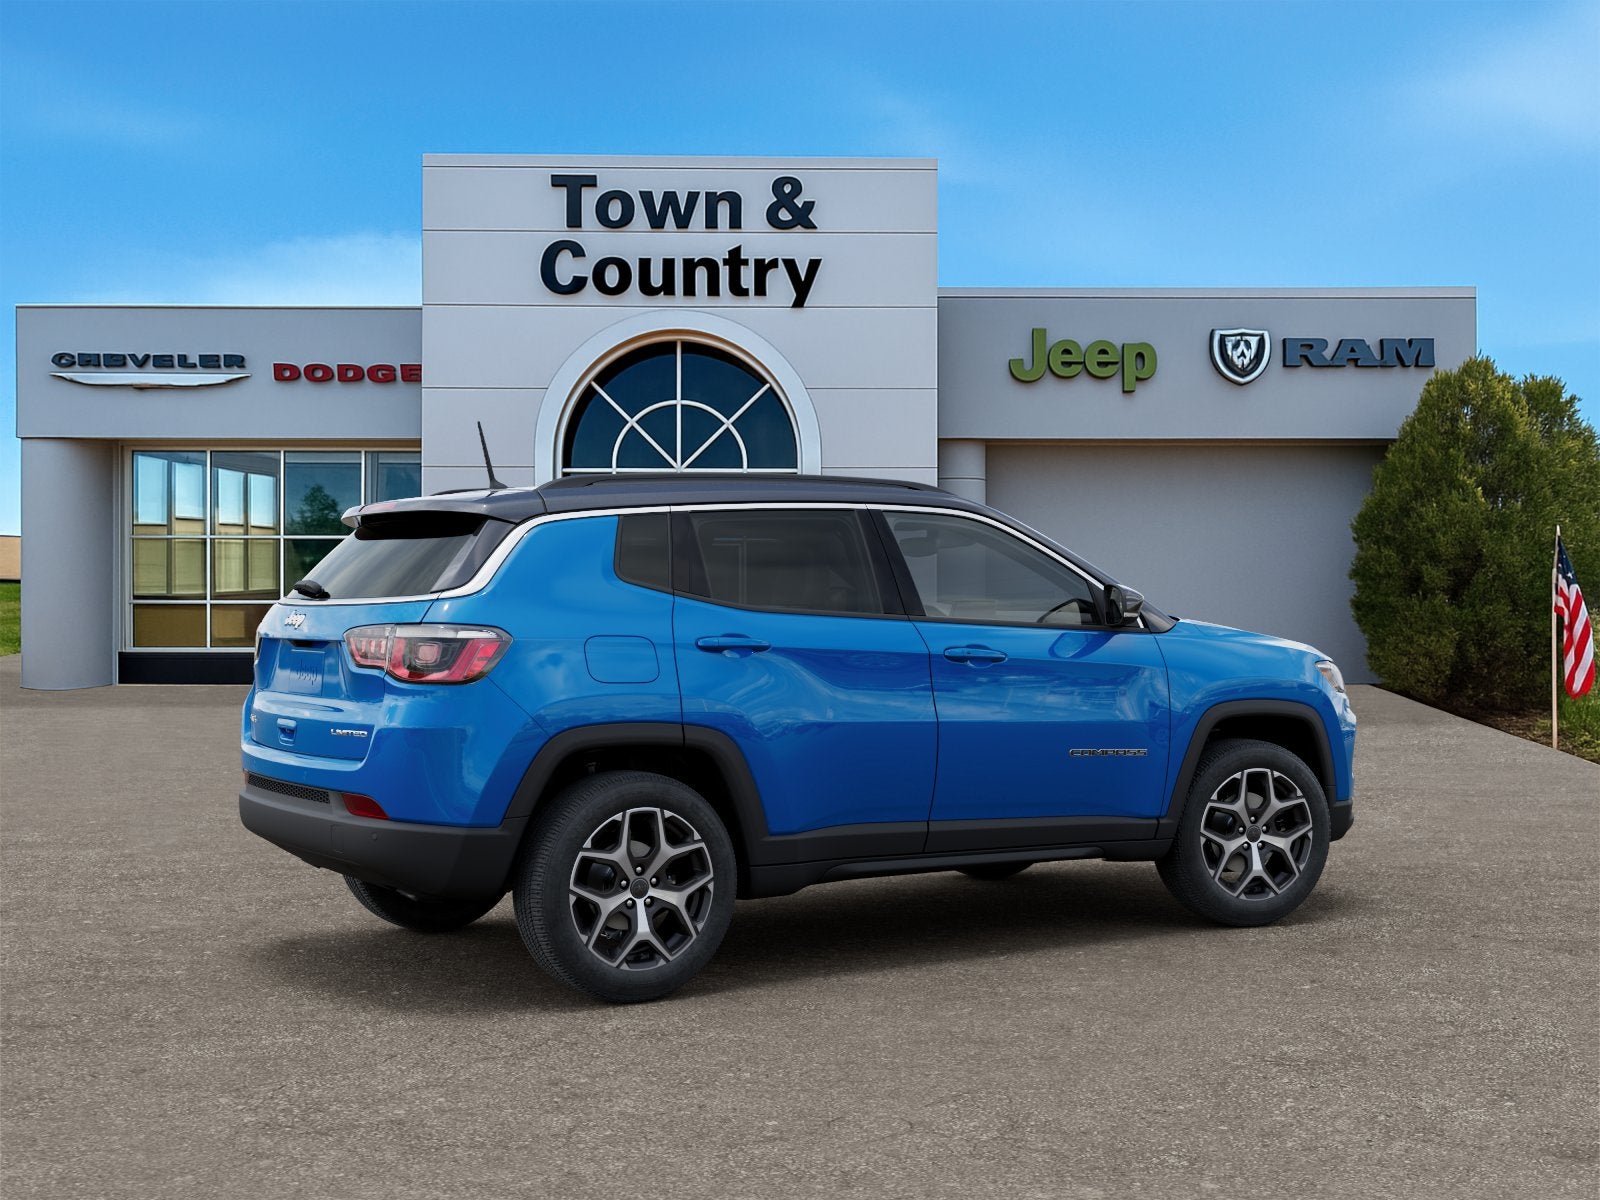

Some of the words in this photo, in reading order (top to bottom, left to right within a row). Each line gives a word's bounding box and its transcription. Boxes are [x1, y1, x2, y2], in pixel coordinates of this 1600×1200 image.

[550, 174, 743, 229] Town
[765, 176, 818, 230] &
[540, 239, 822, 308] Country
[273, 362, 422, 383] DODGE
[1008, 327, 1158, 393] Jeep
[1282, 337, 1436, 368] RAM
[1069, 748, 1148, 757] COMPASS
